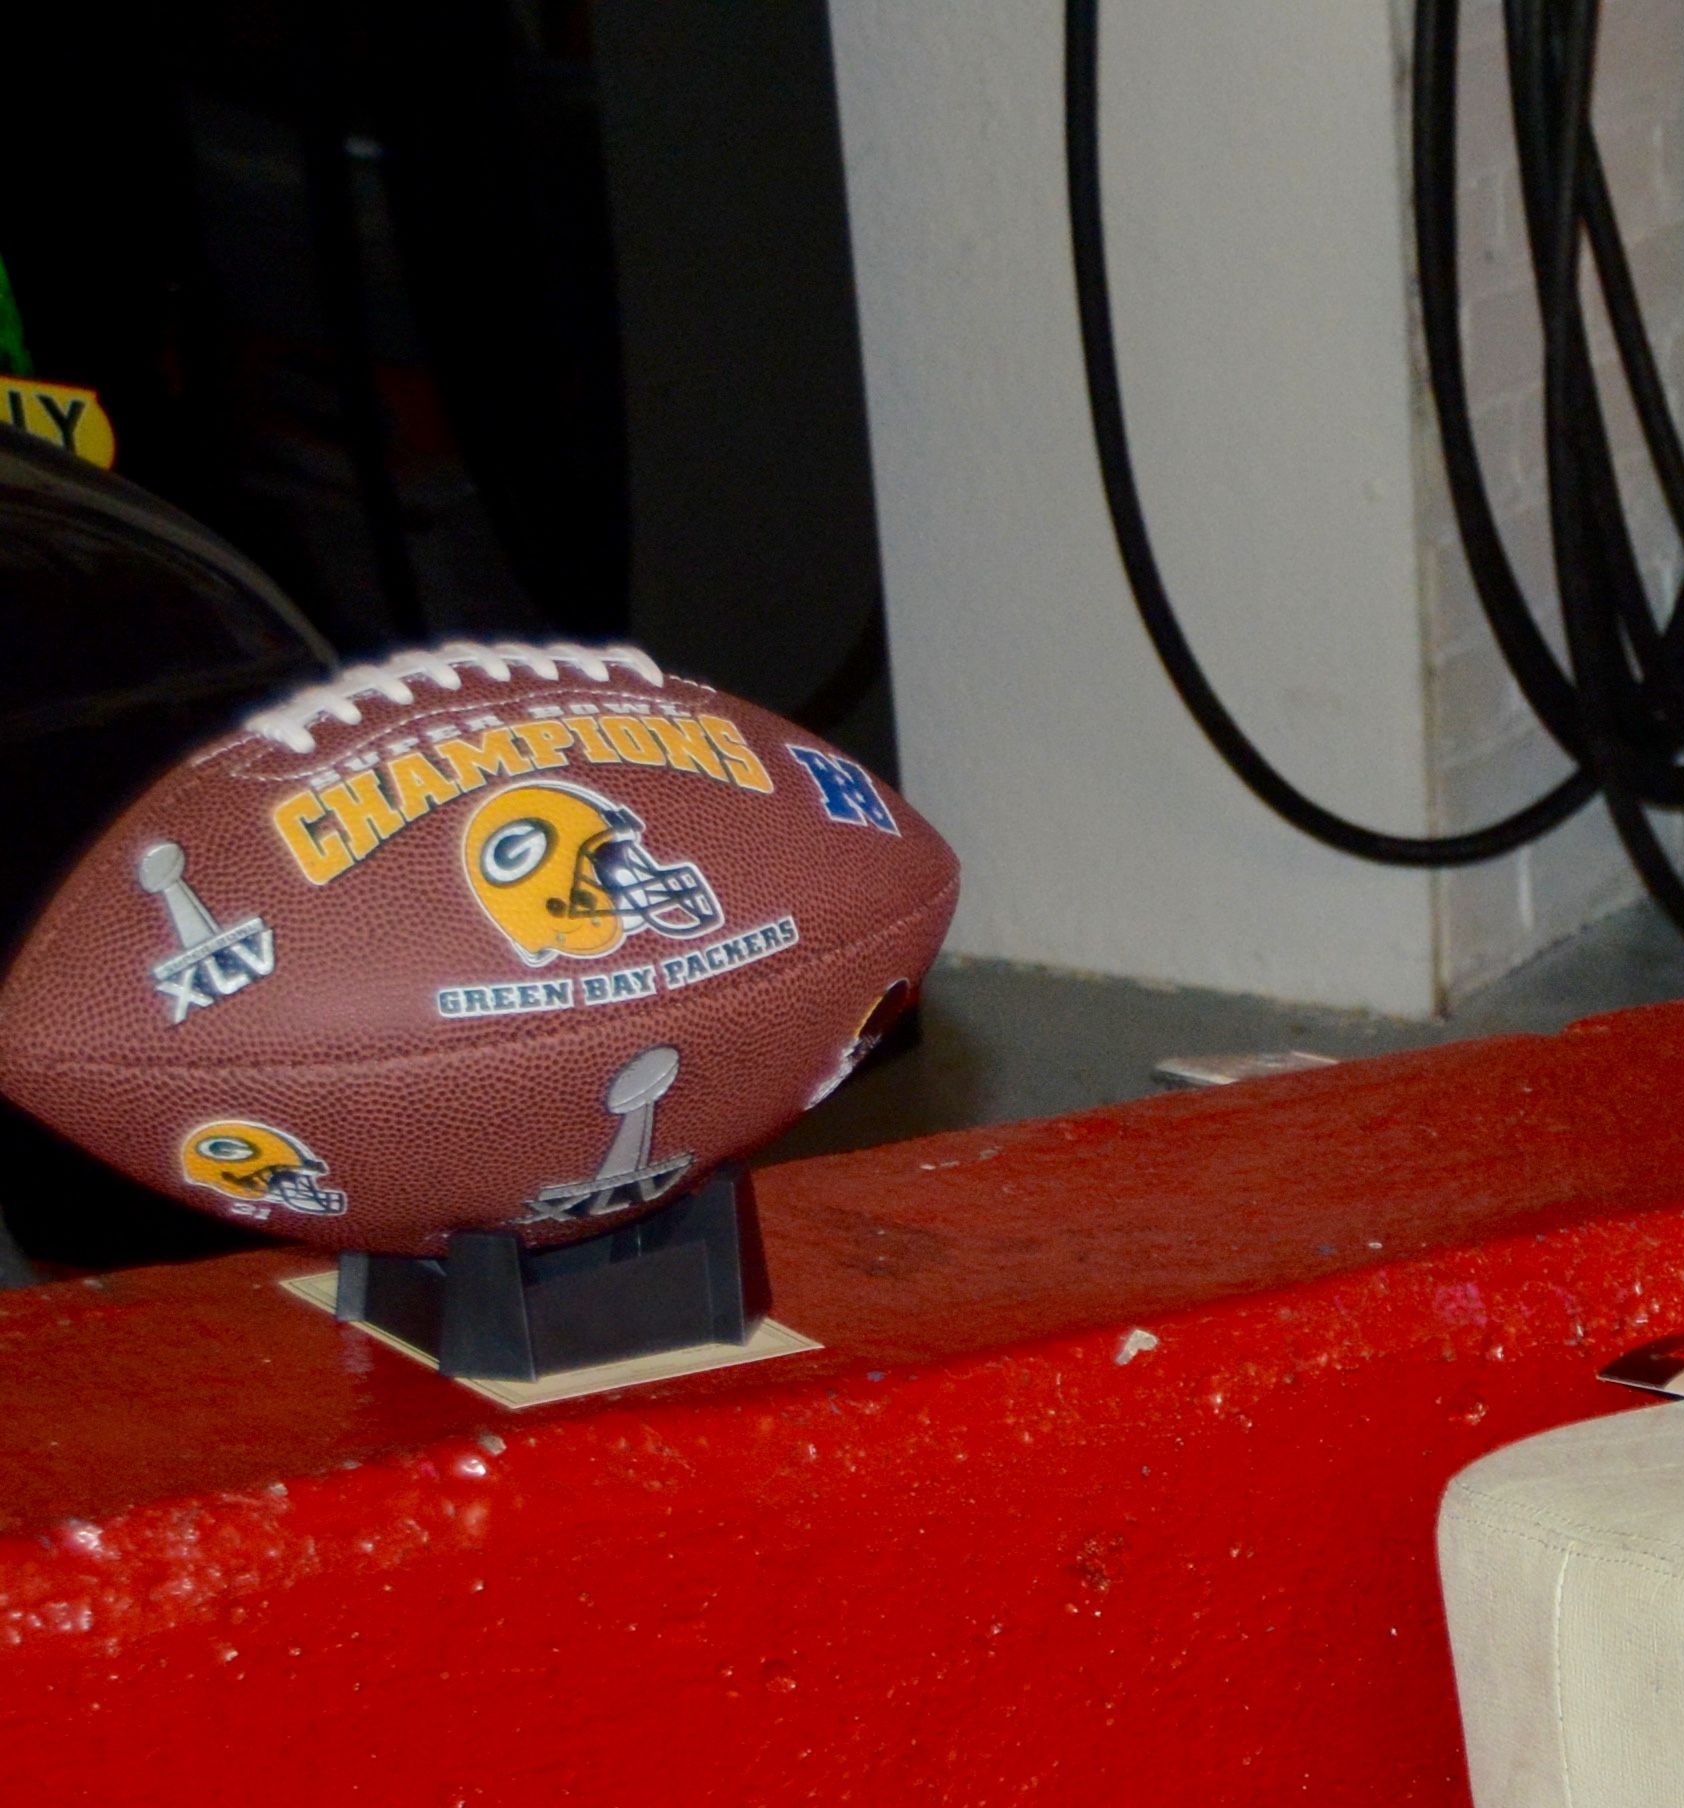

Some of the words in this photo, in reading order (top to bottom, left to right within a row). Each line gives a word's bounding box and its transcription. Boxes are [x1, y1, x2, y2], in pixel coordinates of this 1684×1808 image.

[309, 713, 504, 791] SUPER
[528, 703, 692, 719] BOWL
[273, 714, 774, 886] CHAMPIONS
[155, 928, 276, 1025] XLV
[438, 979, 574, 1018] GREEN
[582, 965, 656, 1005] BAY
[662, 915, 800, 990] PACKERS
